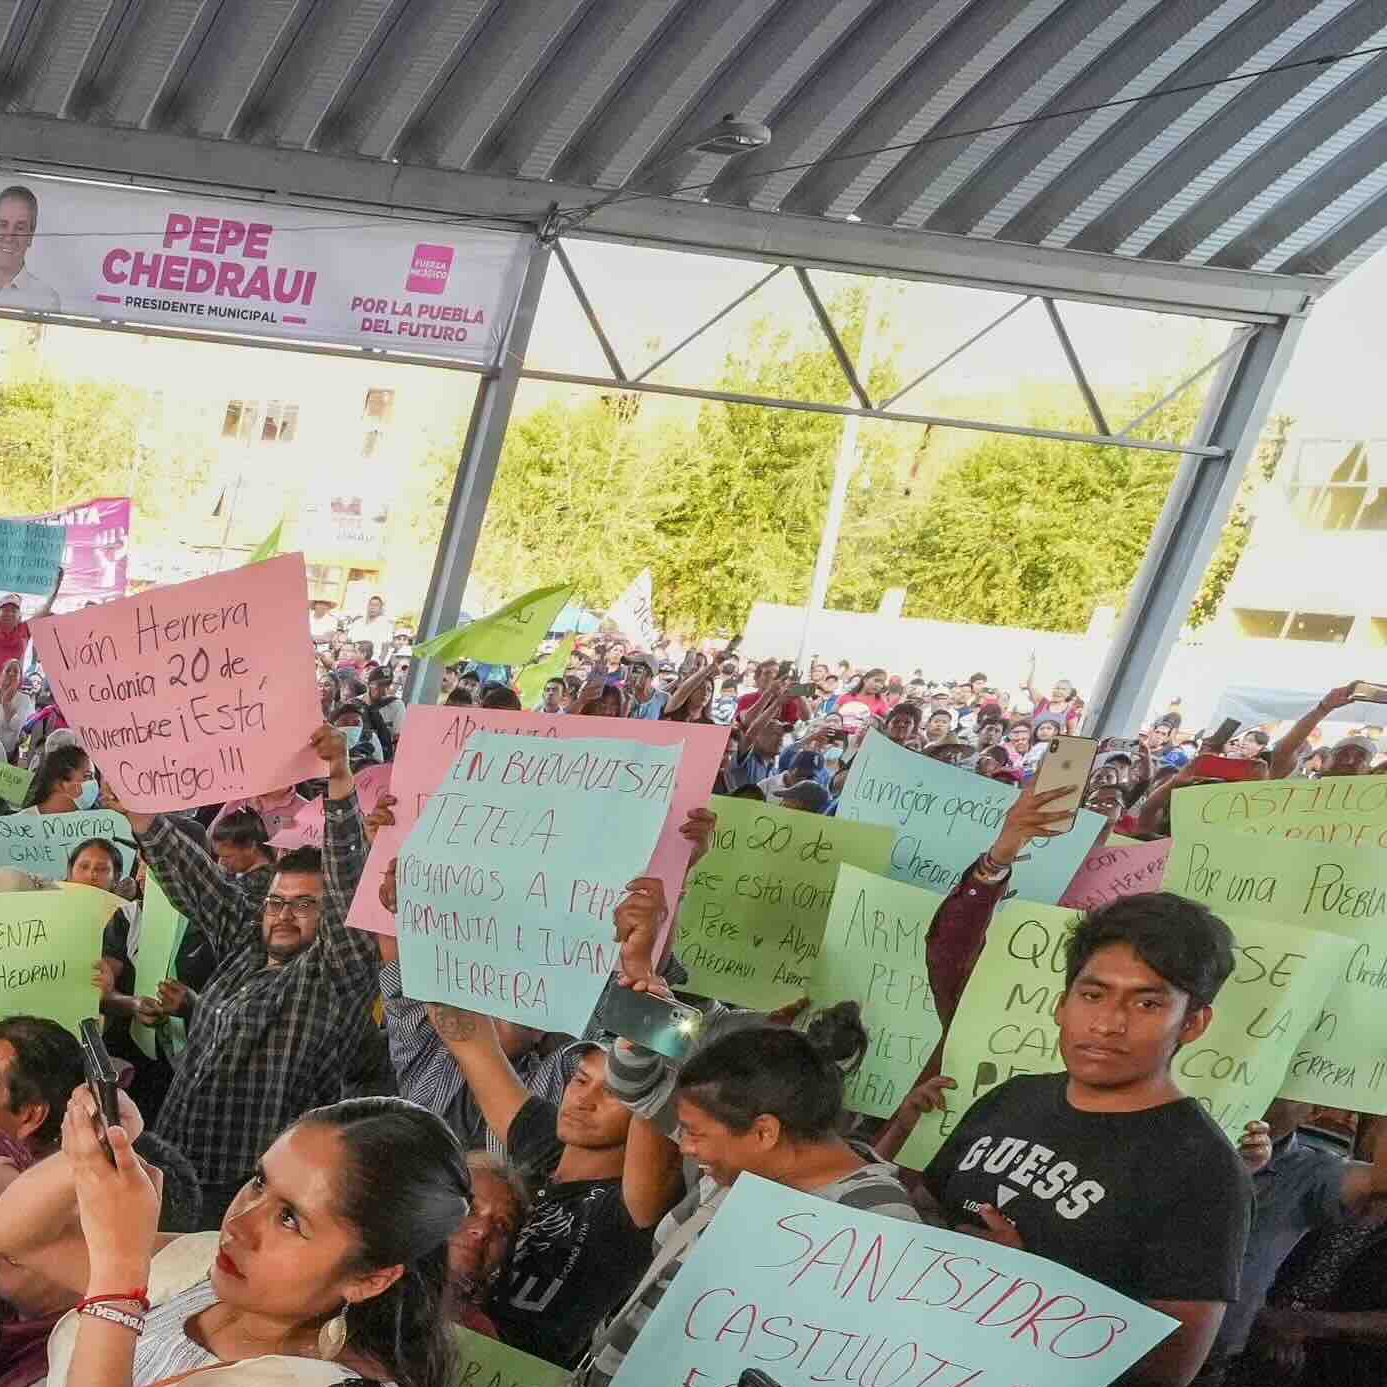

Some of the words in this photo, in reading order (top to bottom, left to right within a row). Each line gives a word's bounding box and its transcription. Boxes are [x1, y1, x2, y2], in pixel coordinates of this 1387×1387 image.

[163, 213, 273, 260] PEPE
[102, 248, 318, 306] CHEDRAUI
[125, 296, 204, 315] PRESIDENTE
[207, 303, 278, 323] MUNICIPAL
[351, 296, 387, 315] POR
[392, 301, 413, 318] LA
[417, 303, 484, 325] PUEBLA
[361, 318, 393, 335] DEL
[397, 322, 467, 342] FUTURO
[53, 628, 118, 671] Iván
[134, 602, 251, 654] Herrera
[58, 679, 79, 705] la
[168, 647, 210, 687] 20
[219, 648, 249, 679] de
[79, 711, 172, 752] noviembre
[746, 815, 794, 854] 20
[802, 832, 833, 864] de
[526, 872, 550, 908] A
[1227, 873, 1277, 903] una
[402, 899, 500, 952] ARMENTA
[845, 888, 925, 957] ARM
[434, 944, 550, 1015] HERRERA
[1180, 1048, 1256, 1088] CON
[958, 1136, 1105, 1219] GUESS
